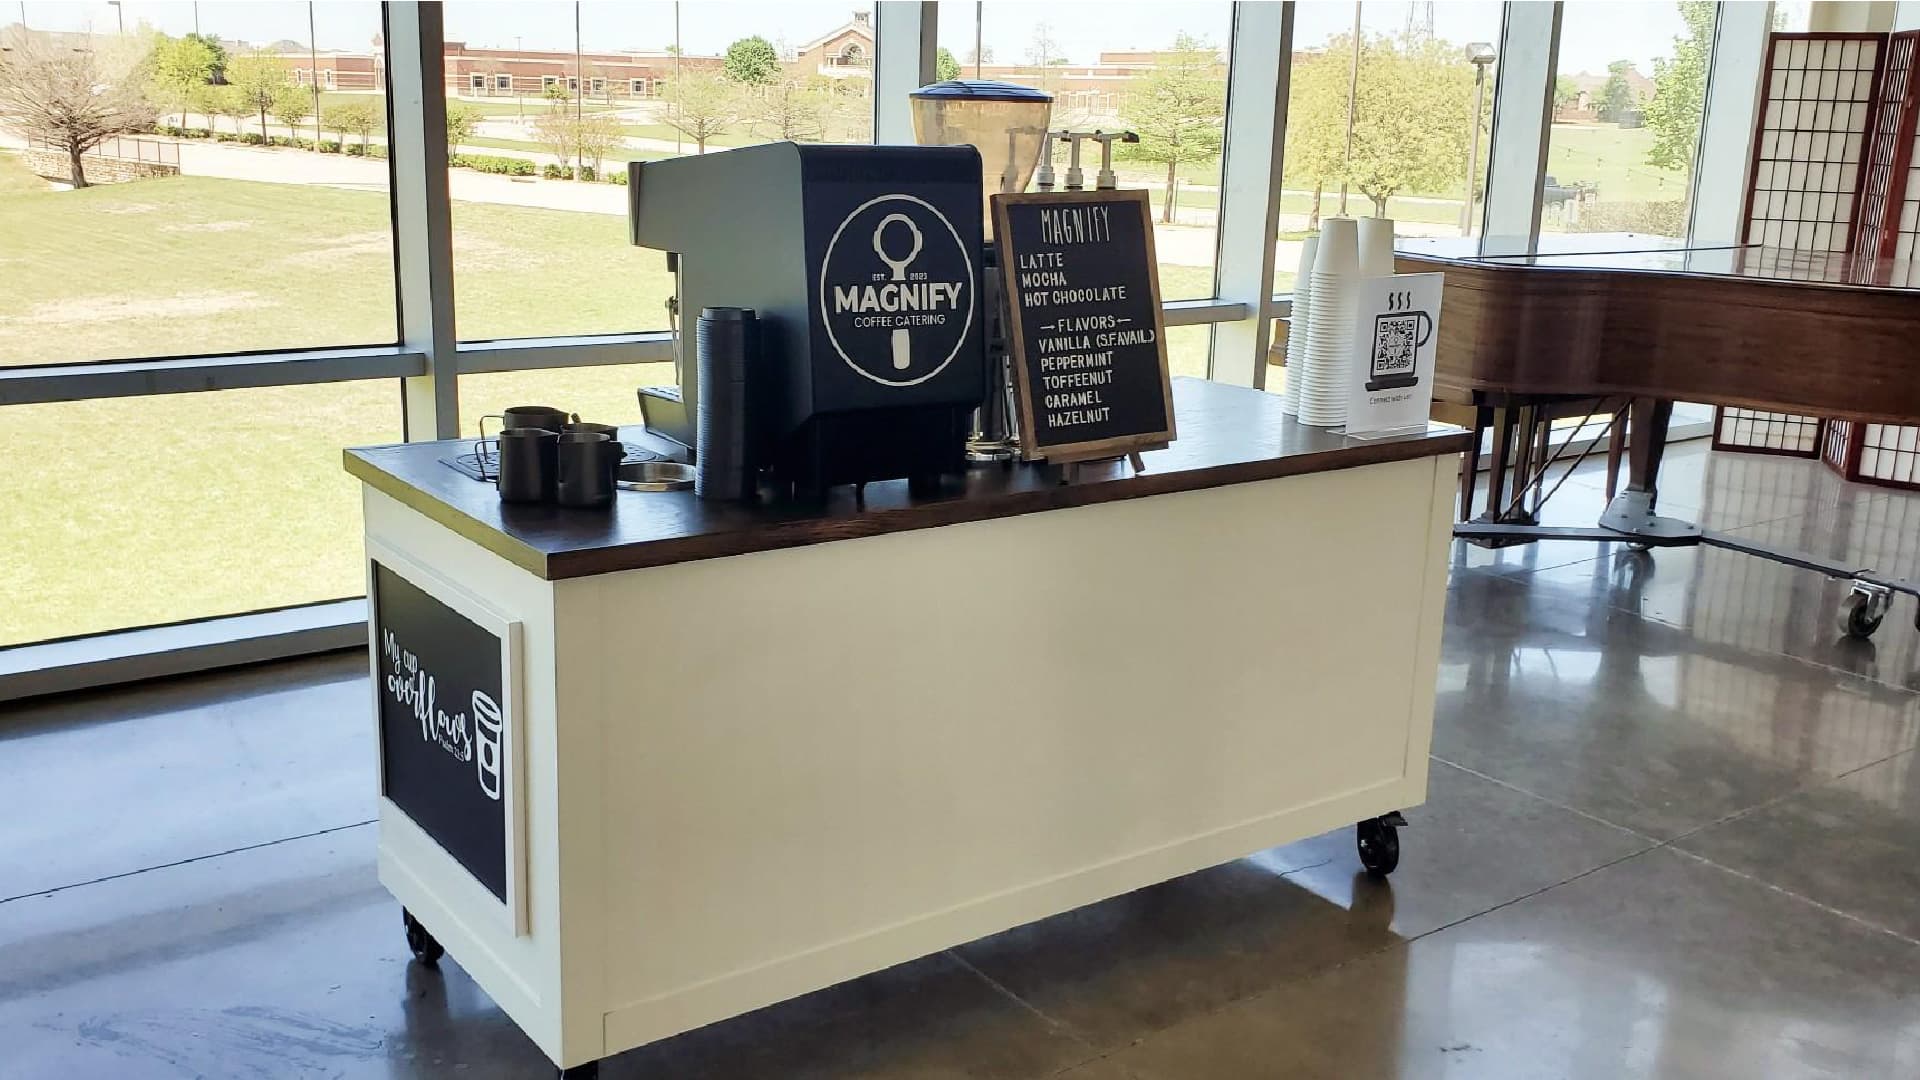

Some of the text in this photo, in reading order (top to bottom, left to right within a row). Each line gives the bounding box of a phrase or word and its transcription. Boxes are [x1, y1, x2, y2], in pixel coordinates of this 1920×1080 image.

[1041, 206, 1110, 245] MAGNIFY
[1020, 252, 1064, 269] LATTE
[1022, 272, 1067, 289] MOCHA
[833, 282, 963, 314] MAGNIFY
[1025, 286, 1127, 307] HOT CHOCOLATE
[854, 314, 946, 328] COFFEE CATERING
[1058, 315, 1116, 332] FLAVORS
[1038, 335, 1091, 353] VANILLA
[1041, 351, 1113, 372] PEPPERMINT
[1042, 369, 1113, 390] TOFFEENUT
[1045, 390, 1102, 409] CARAMEL
[1048, 407, 1110, 428] HAZELNUT
[384, 627, 418, 678] My cup
[388, 670, 473, 762] overflows
